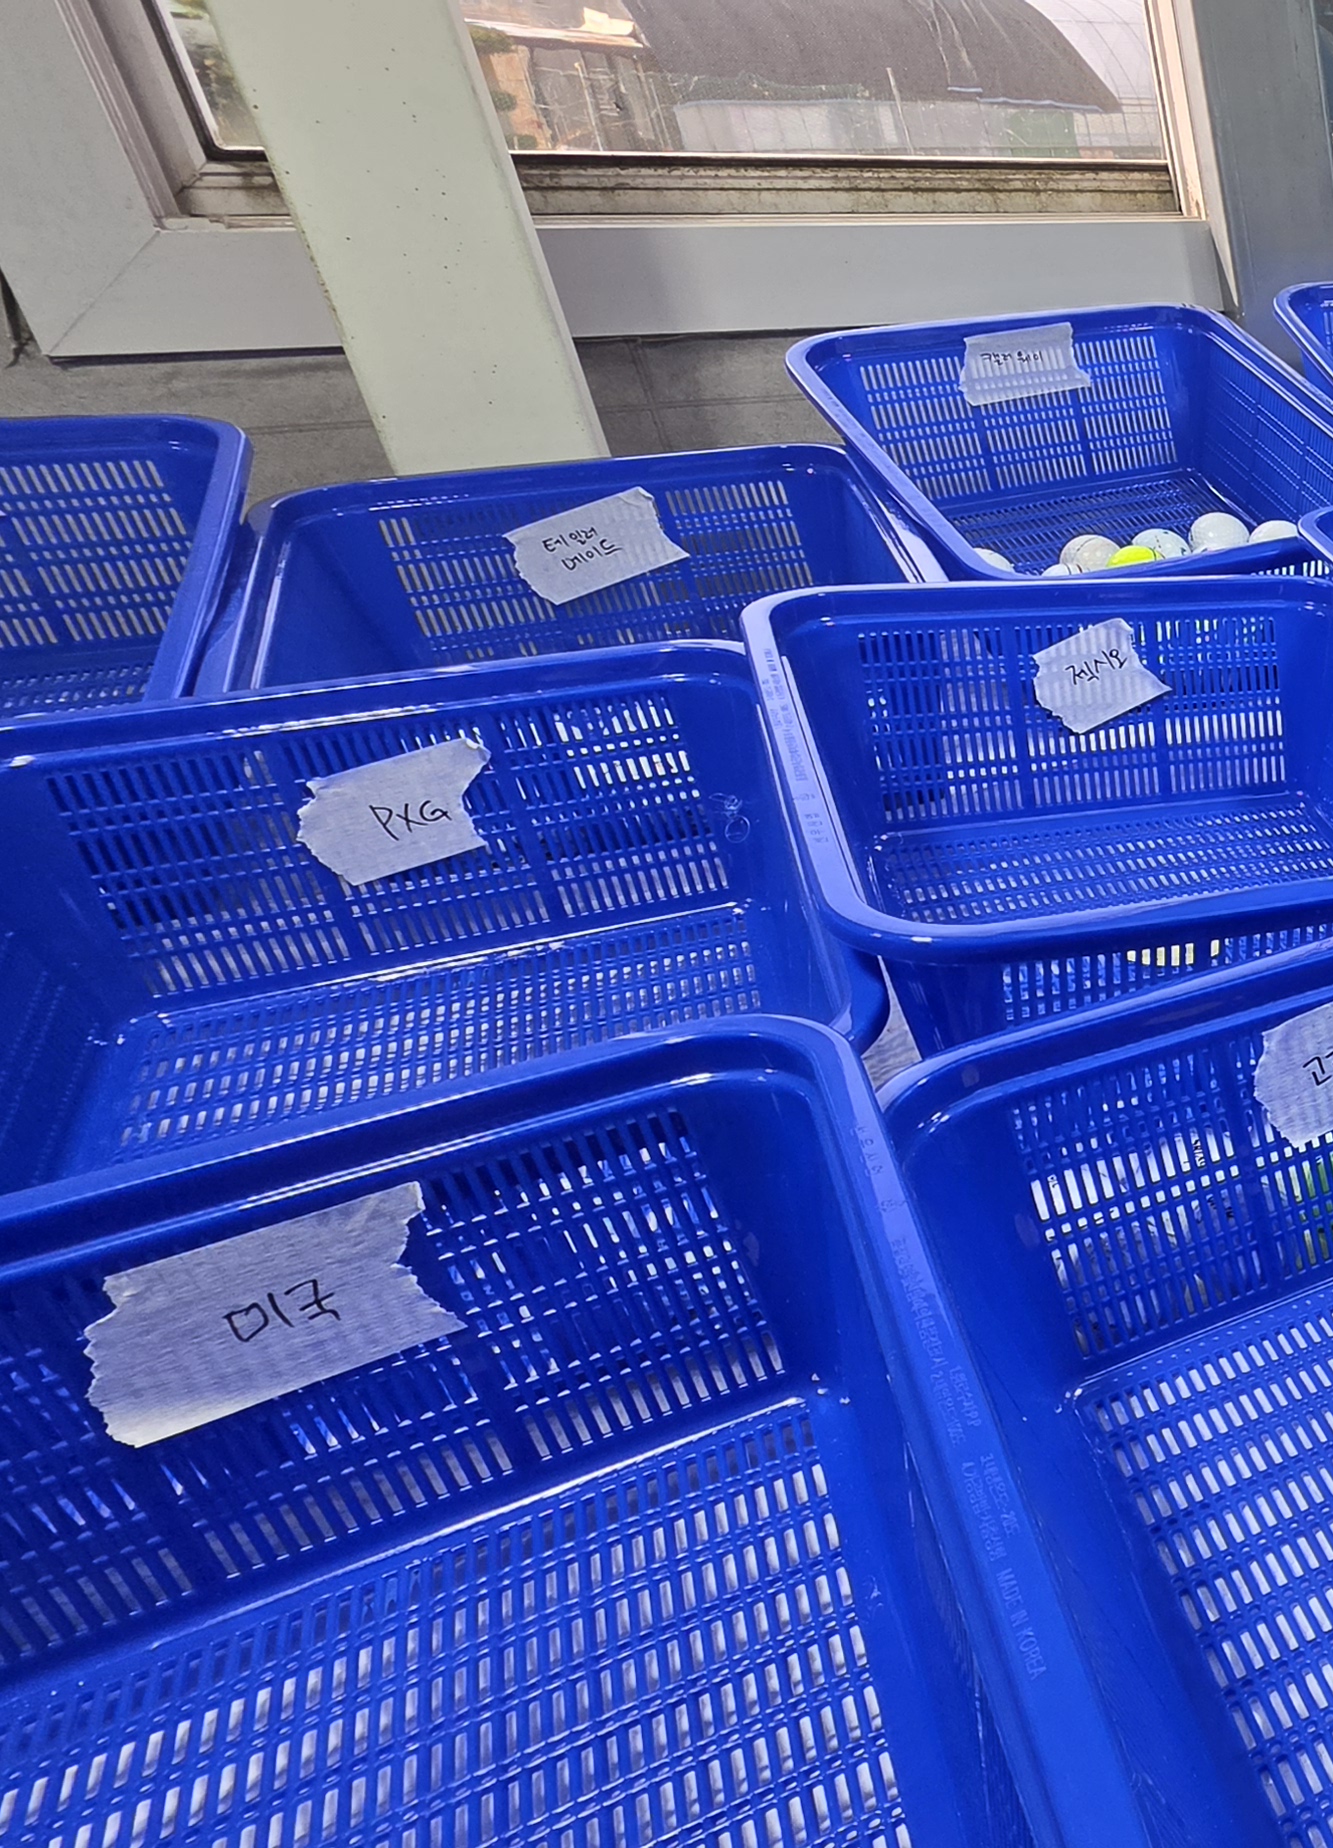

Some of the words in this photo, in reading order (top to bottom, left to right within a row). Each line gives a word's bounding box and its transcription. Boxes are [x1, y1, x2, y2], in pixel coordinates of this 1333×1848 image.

[542, 527, 599, 552] 테일러
[561, 539, 624, 571] 메이드
[1065, 649, 1128, 685] 젝시오
[369, 799, 452, 841] PXG
[995, 1566, 1024, 1610] MADE
[1014, 1626, 1049, 1682] KOREA
